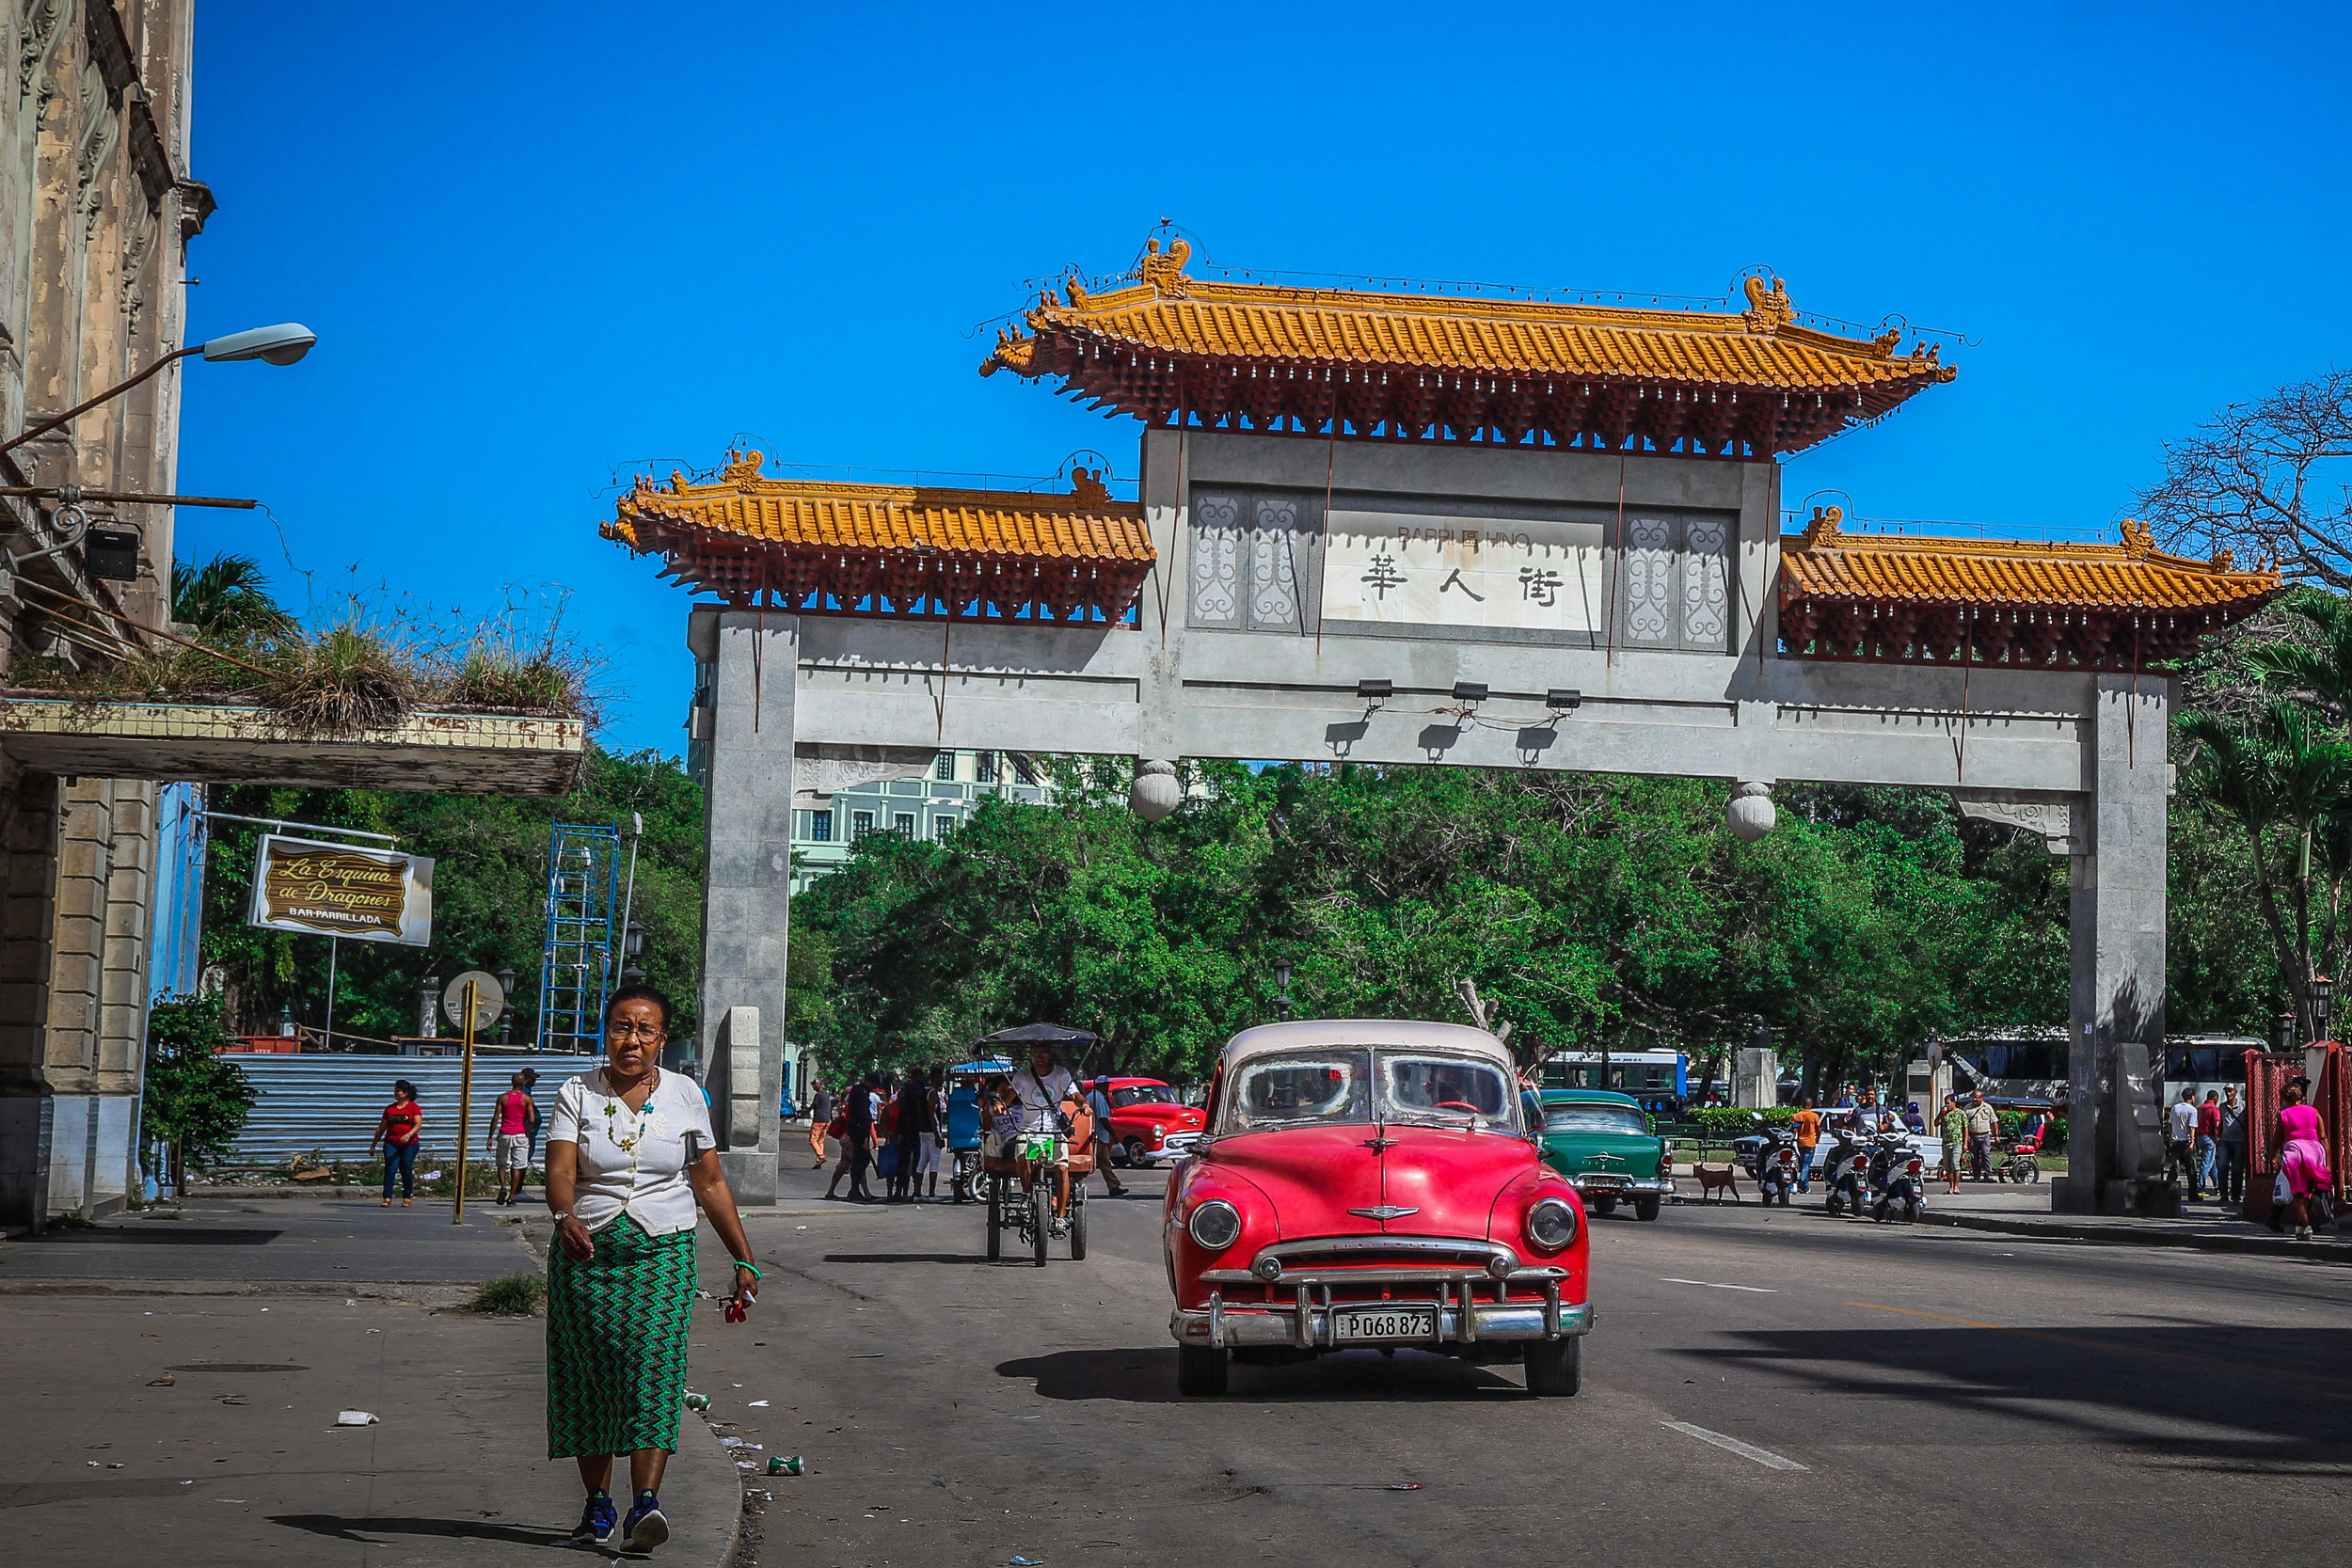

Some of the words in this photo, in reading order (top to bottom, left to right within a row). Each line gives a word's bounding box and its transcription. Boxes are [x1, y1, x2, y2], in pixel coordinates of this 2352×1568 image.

[1360, 554, 1564, 607] 華人街
[278, 858, 311, 879] La
[318, 860, 391, 887] Esquina
[278, 886, 298, 898] de
[305, 880, 390, 910] Dragones
[1363, 1317, 1395, 1336] 068
[1400, 1314, 1432, 1335] 873
